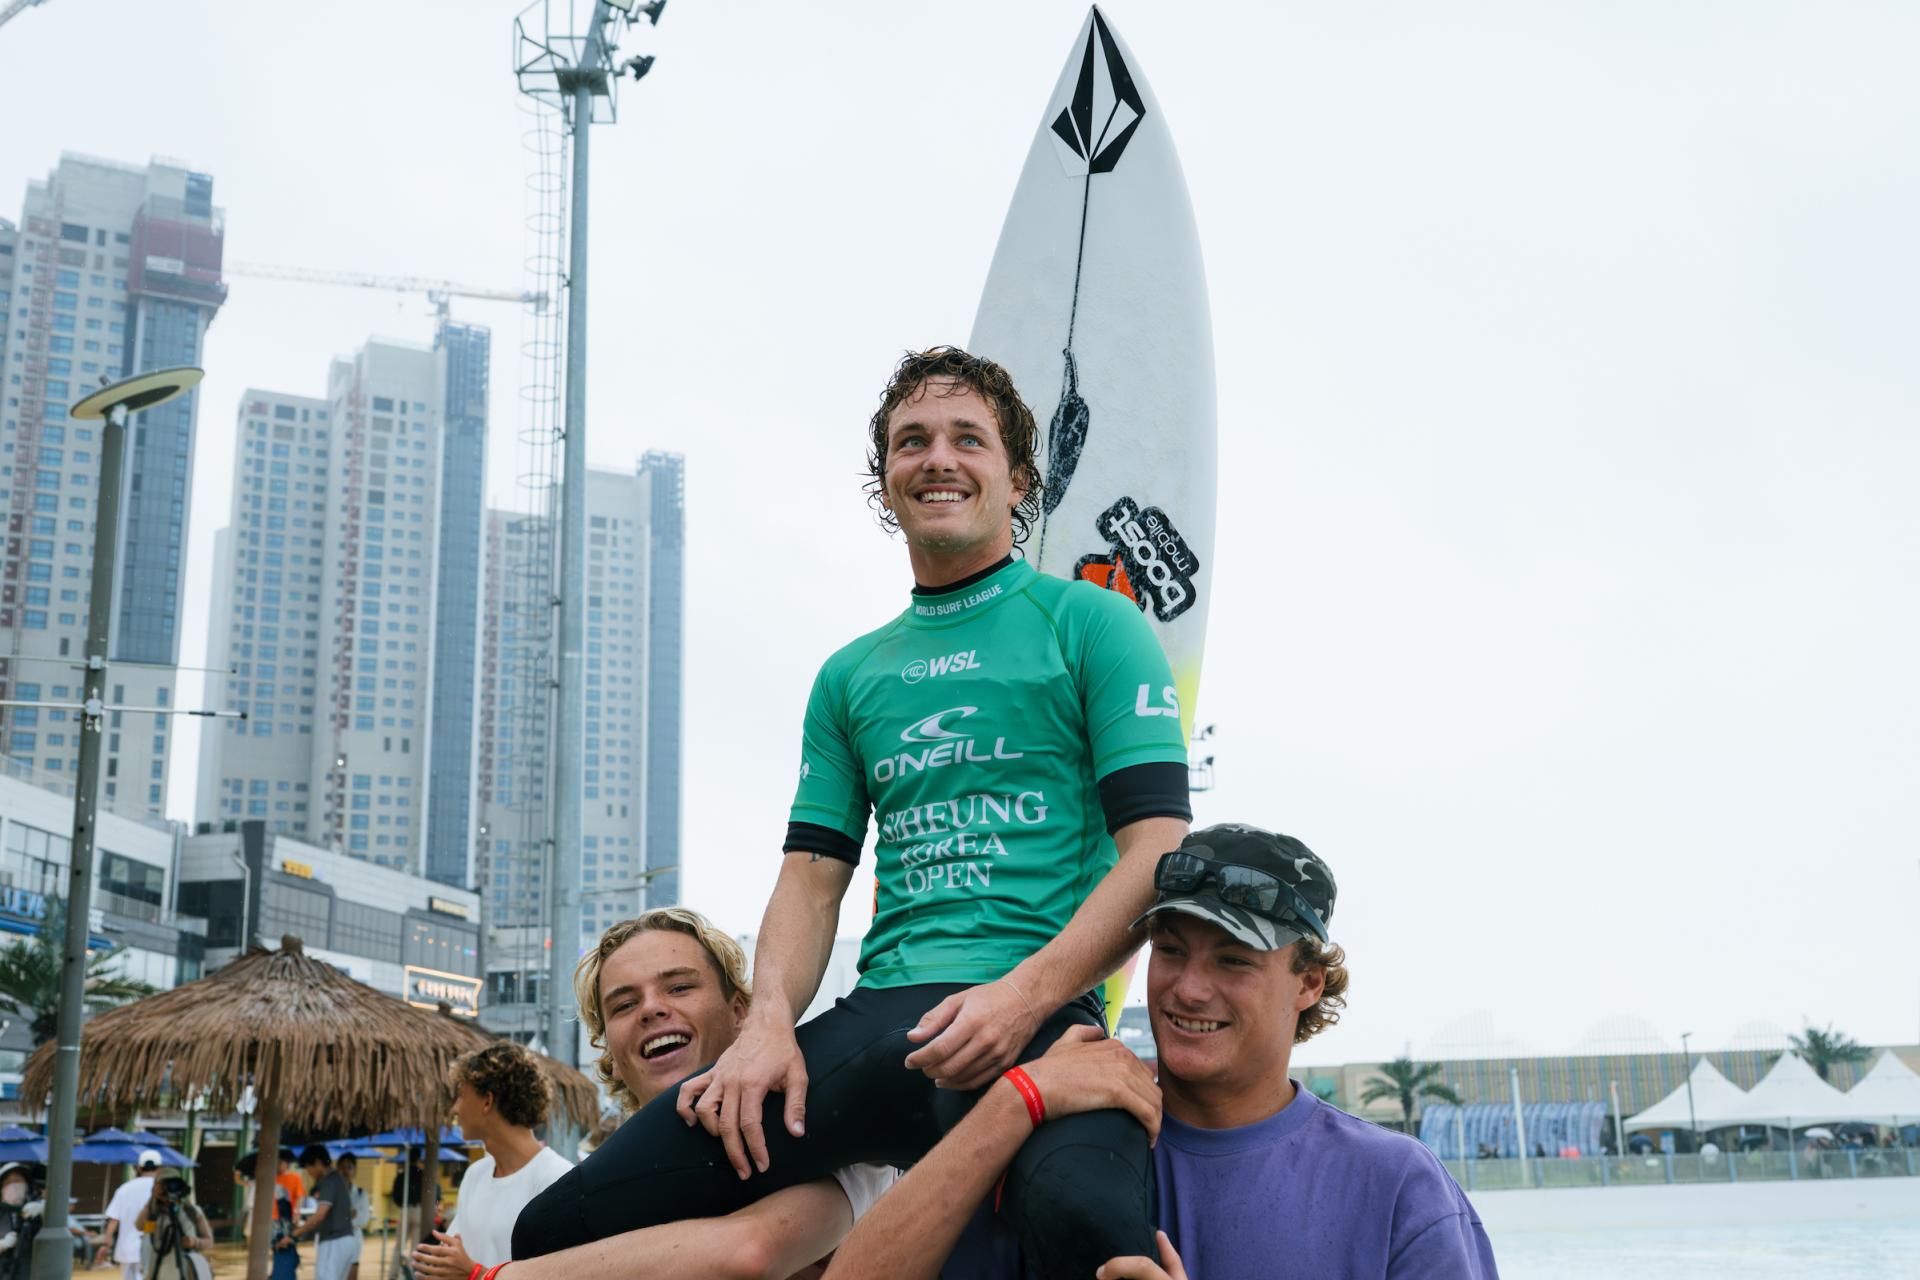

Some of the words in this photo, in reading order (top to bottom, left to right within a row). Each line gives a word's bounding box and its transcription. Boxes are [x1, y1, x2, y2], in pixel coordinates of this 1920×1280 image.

[1108, 506, 1187, 613] boost
[1146, 515, 1190, 572] mobile
[936, 600, 963, 616] SURF
[963, 584, 1004, 609] LEAGUE
[929, 650, 981, 677] WSL
[874, 737, 1024, 783] O'NEILL
[882, 791, 1049, 844] SIHEUNG
[900, 832, 1009, 870] KOREA
[904, 862, 993, 894] OPEN
